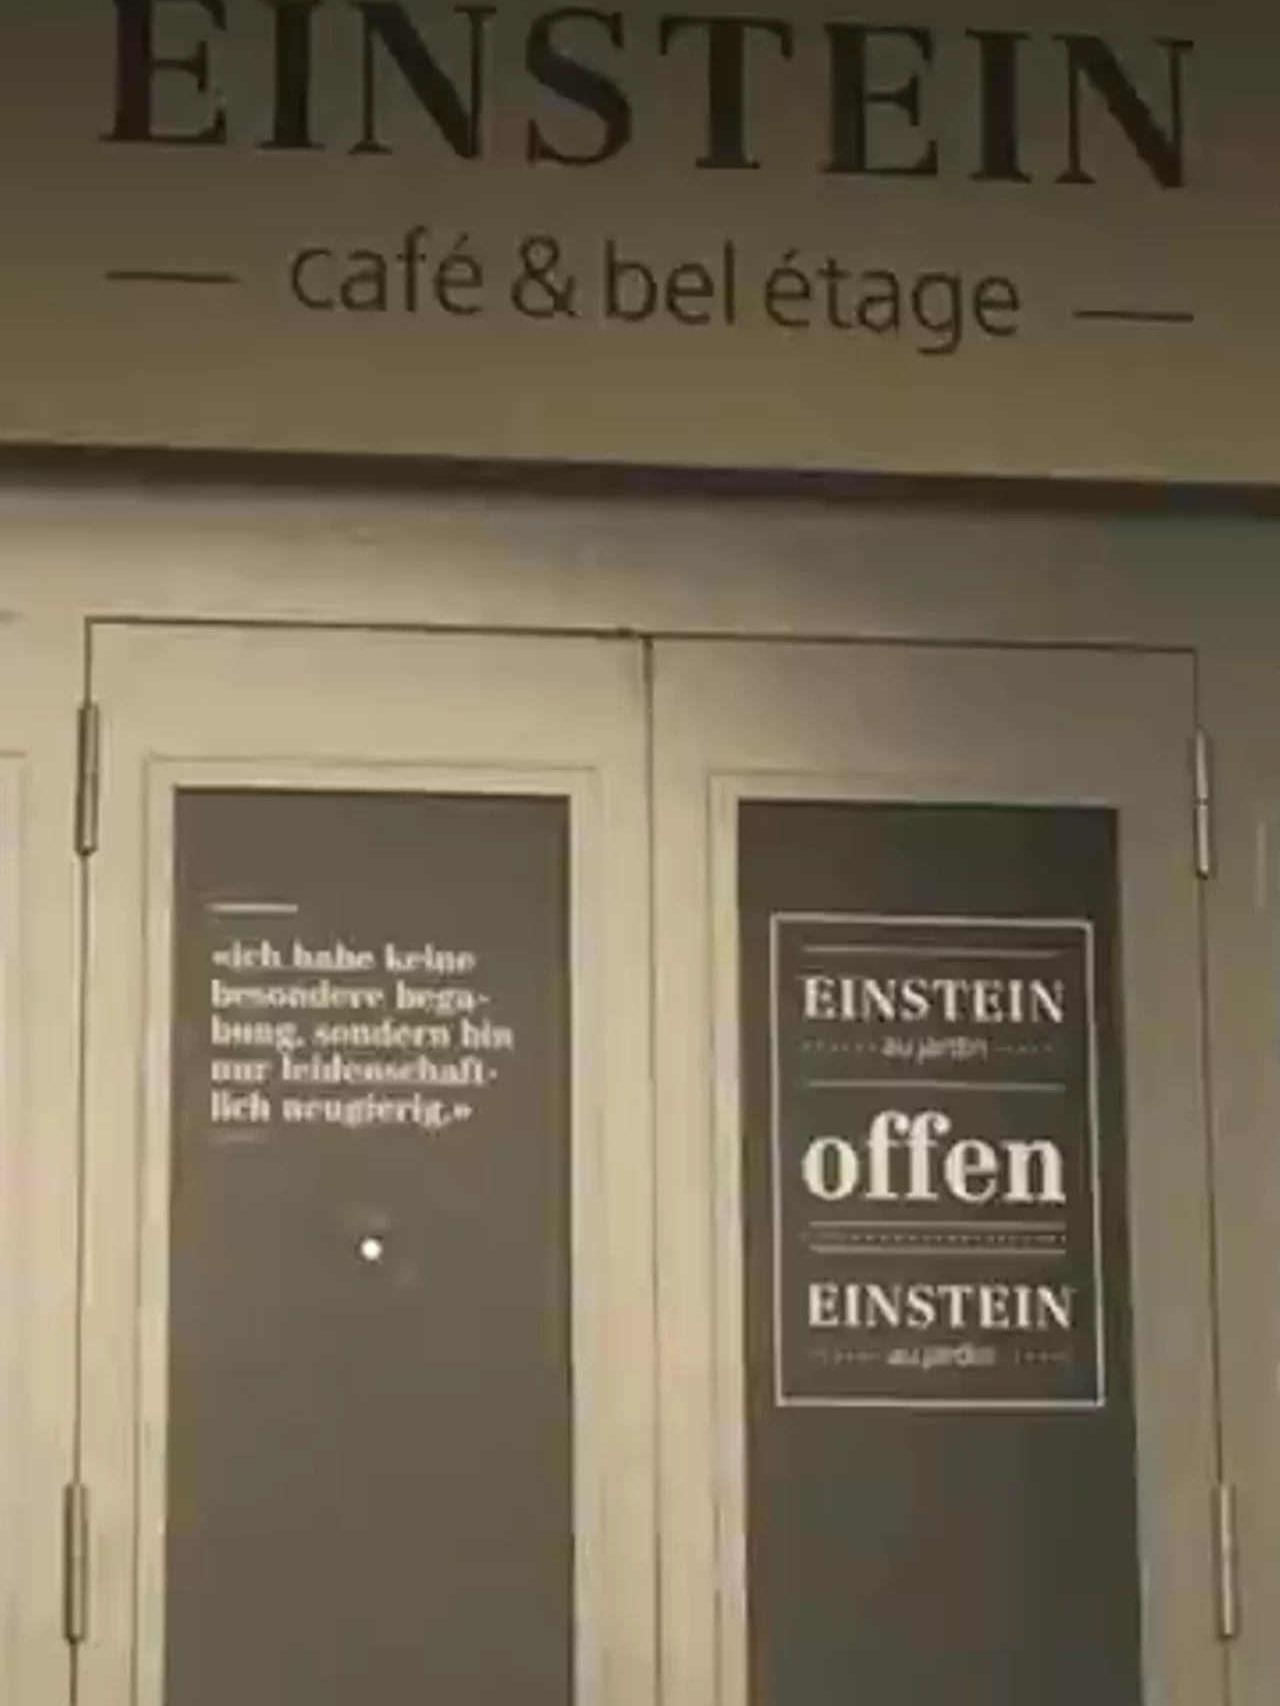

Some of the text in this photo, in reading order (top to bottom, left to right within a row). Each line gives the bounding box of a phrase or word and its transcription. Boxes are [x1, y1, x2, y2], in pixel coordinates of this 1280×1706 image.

[287, 226, 1022, 355] café & bel étage
[292, 938, 377, 971] habe
[384, 943, 477, 974] keine
[800, 976, 1065, 1024] EINSTEIN
[313, 1018, 452, 1049] sondern
[210, 1059, 273, 1083] nur
[801, 1110, 1067, 1203] offen
[807, 1283, 1076, 1330] EINSTEIN
